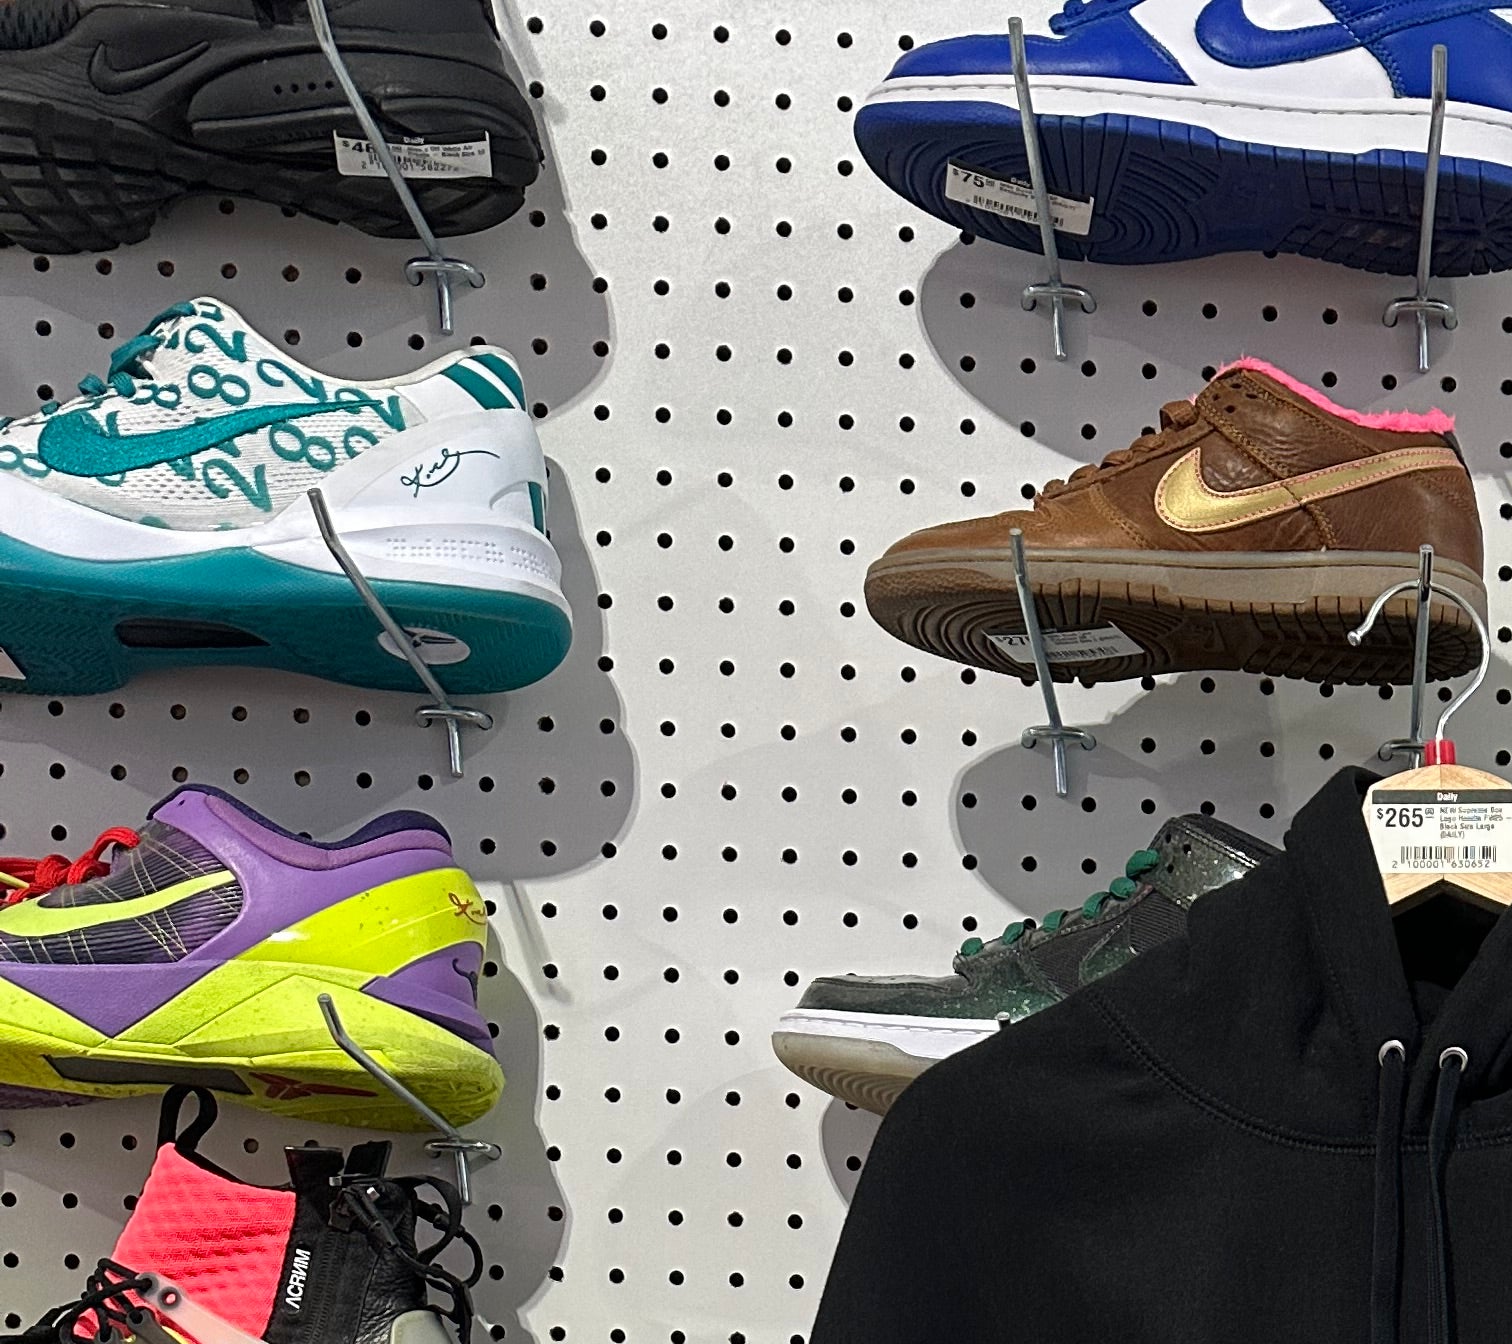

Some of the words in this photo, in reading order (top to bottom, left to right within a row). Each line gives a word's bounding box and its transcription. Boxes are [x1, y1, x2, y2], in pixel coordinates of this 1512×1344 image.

[952, 168, 985, 188] $75
[1437, 792, 1458, 802] Daily
[1377, 807, 1424, 828] $265
[1440, 815, 1457, 823] Logo
[1440, 823, 1458, 831] Black
[1476, 823, 1495, 832] Large
[1392, 860, 1398, 869] 2
[1451, 860, 1490, 869] 630652
